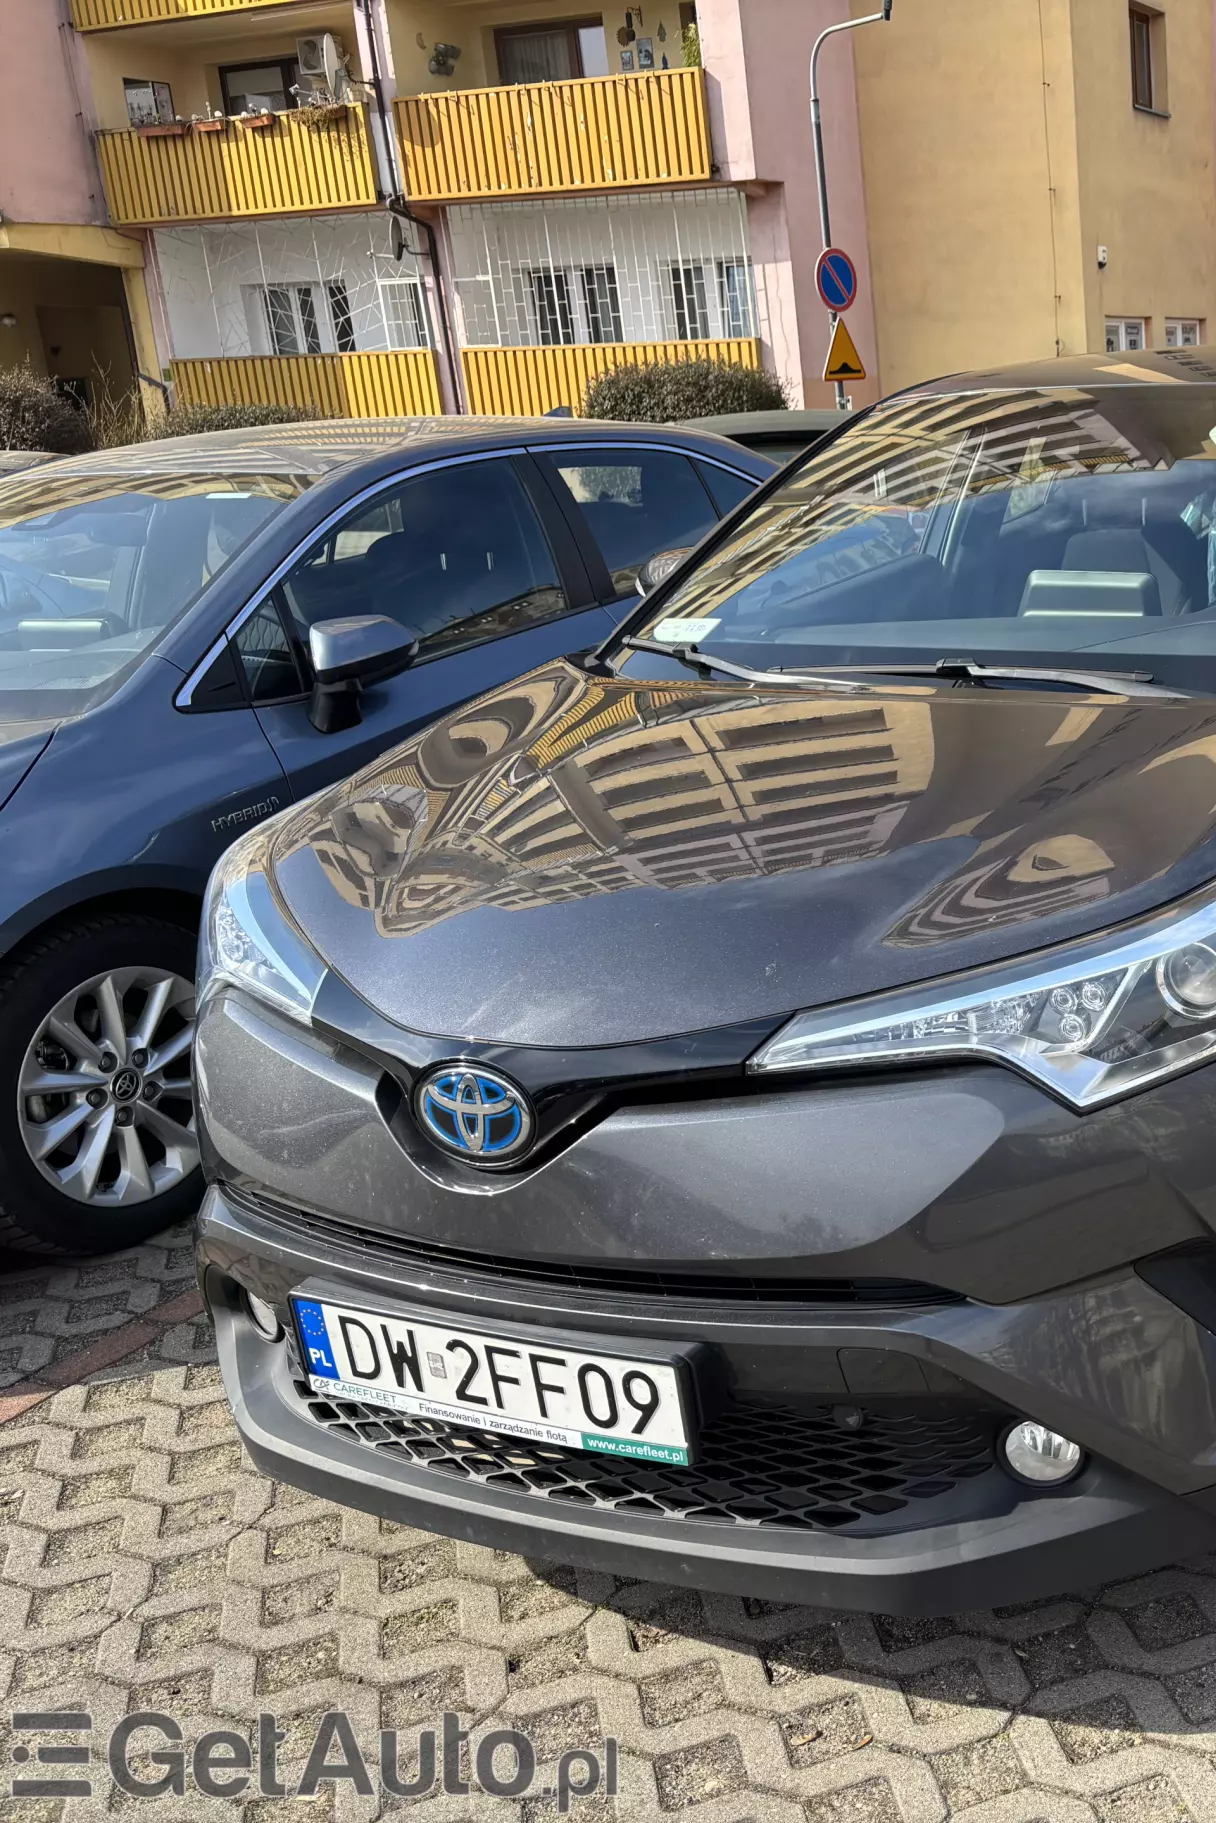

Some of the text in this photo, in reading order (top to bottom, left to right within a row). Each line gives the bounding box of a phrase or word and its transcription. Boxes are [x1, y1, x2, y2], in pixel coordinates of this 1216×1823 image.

[211, 802, 269, 832] HYBRID
[308, 1347, 332, 1368] PL
[338, 1315, 660, 1435] DW 2FF09
[333, 1382, 397, 1403] CAREFLEET
[418, 1402, 568, 1444] Finansowanie i zarządzanie flotą
[587, 1438, 685, 1462] www.carefleet.pl
